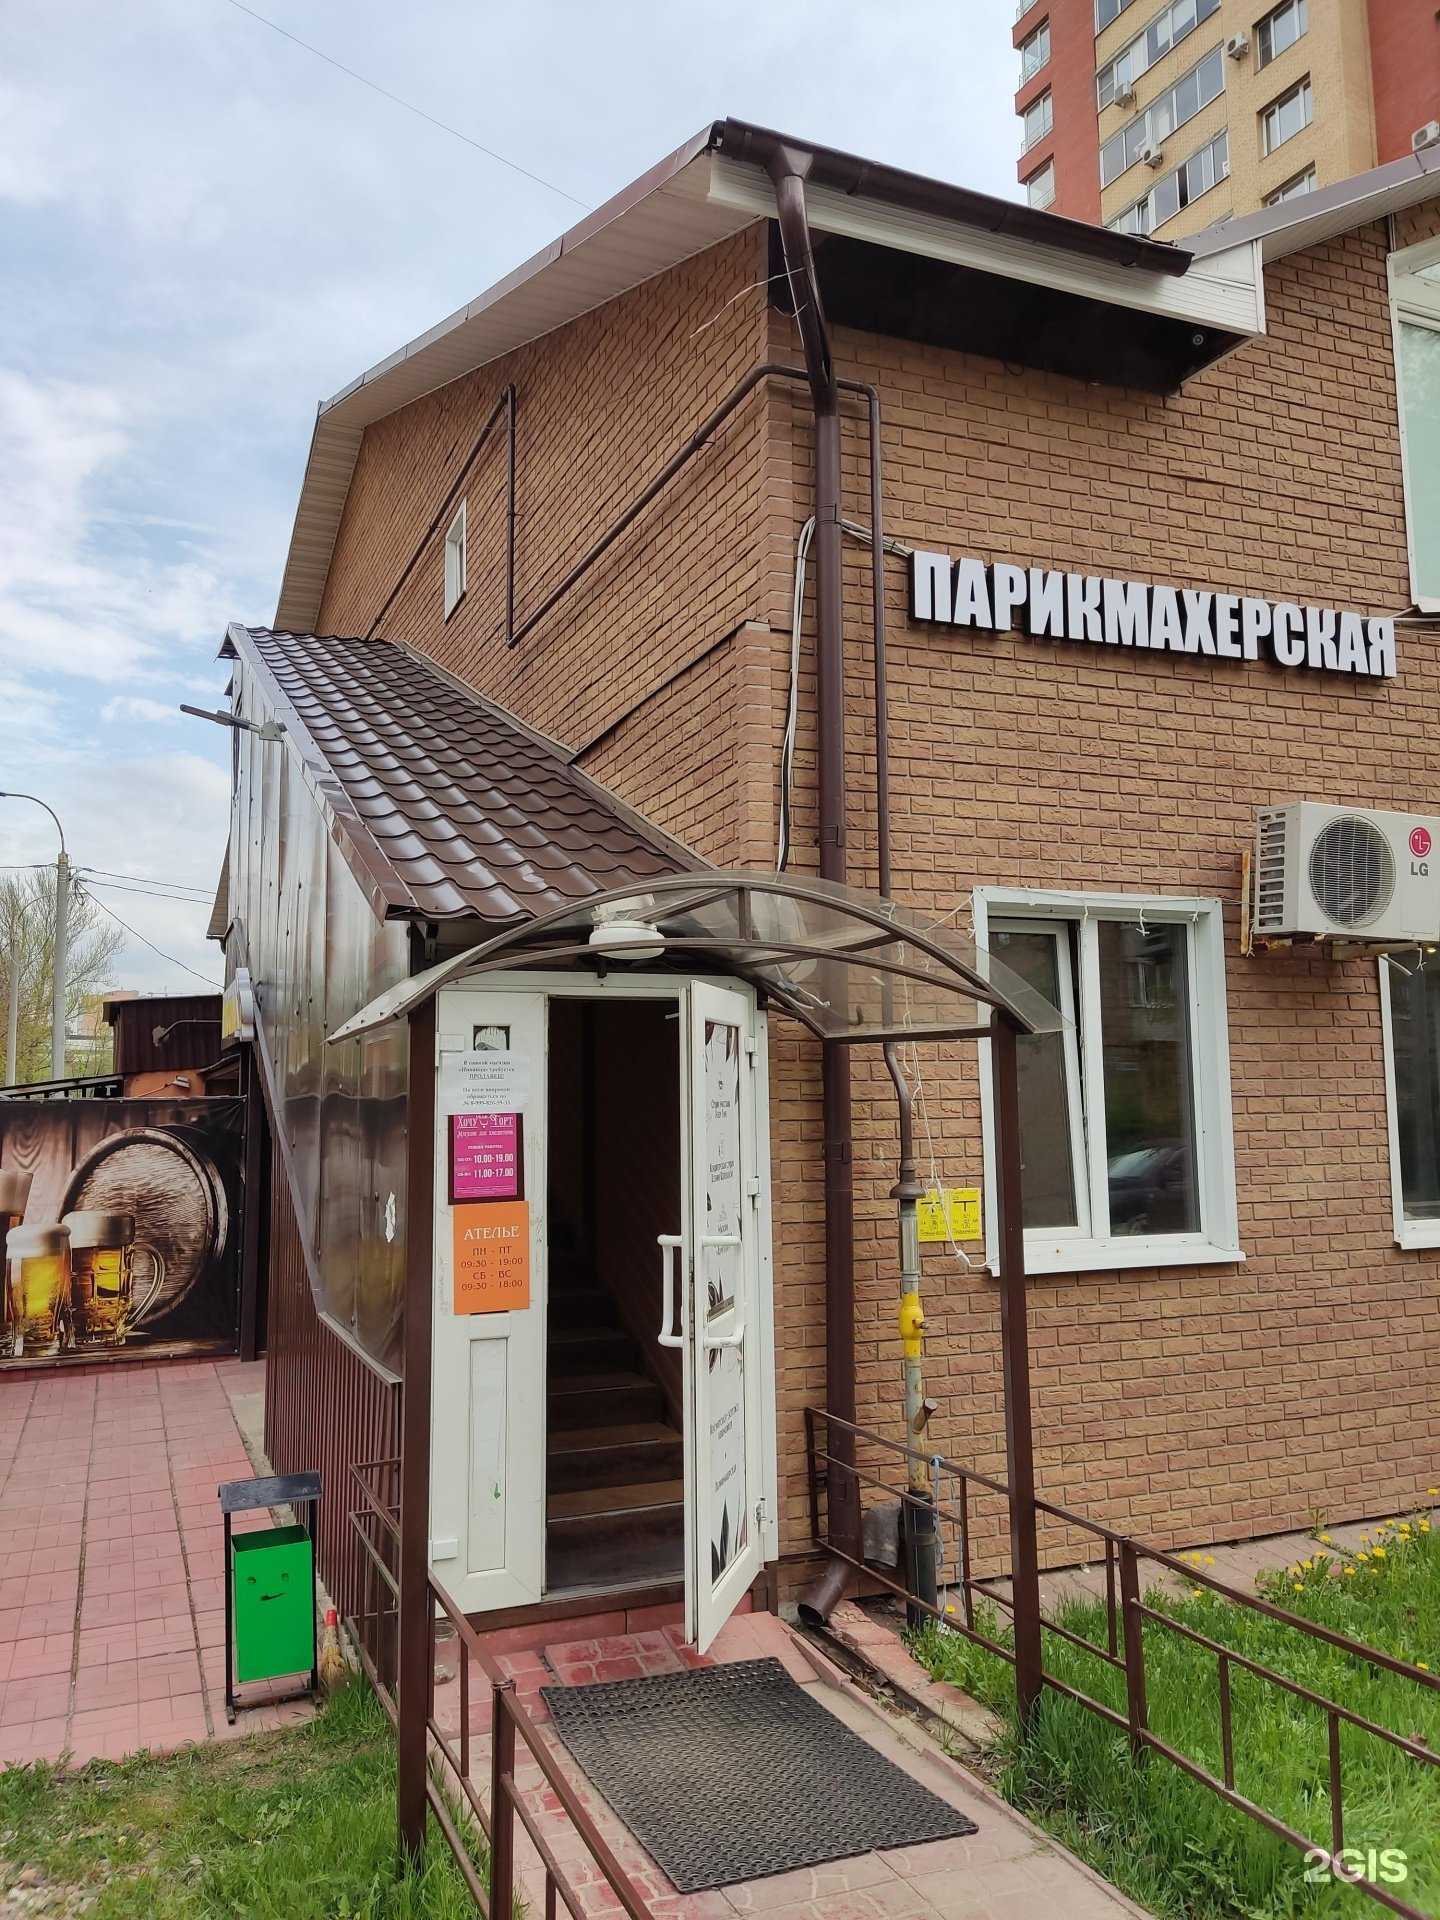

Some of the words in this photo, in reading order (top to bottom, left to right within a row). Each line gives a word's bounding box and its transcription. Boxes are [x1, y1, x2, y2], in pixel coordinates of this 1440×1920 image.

[911, 549, 1397, 679] ПАРИКМАХЕРСКАЯ
[1410, 862, 1429, 877] LG
[464, 1226, 520, 1241] АТЕЛЬЕ
[472, 1247, 487, 1257] ПН
[498, 1246, 512, 1255] ПТ
[461, 1259, 487, 1269] 09:30
[498, 1257, 523, 1266] 19:00
[472, 1271, 486, 1280] СБ
[498, 1269, 512, 1278] ВС
[461, 1281, 487, 1291] 09:30
[498, 1279, 523, 1289] 18:00
